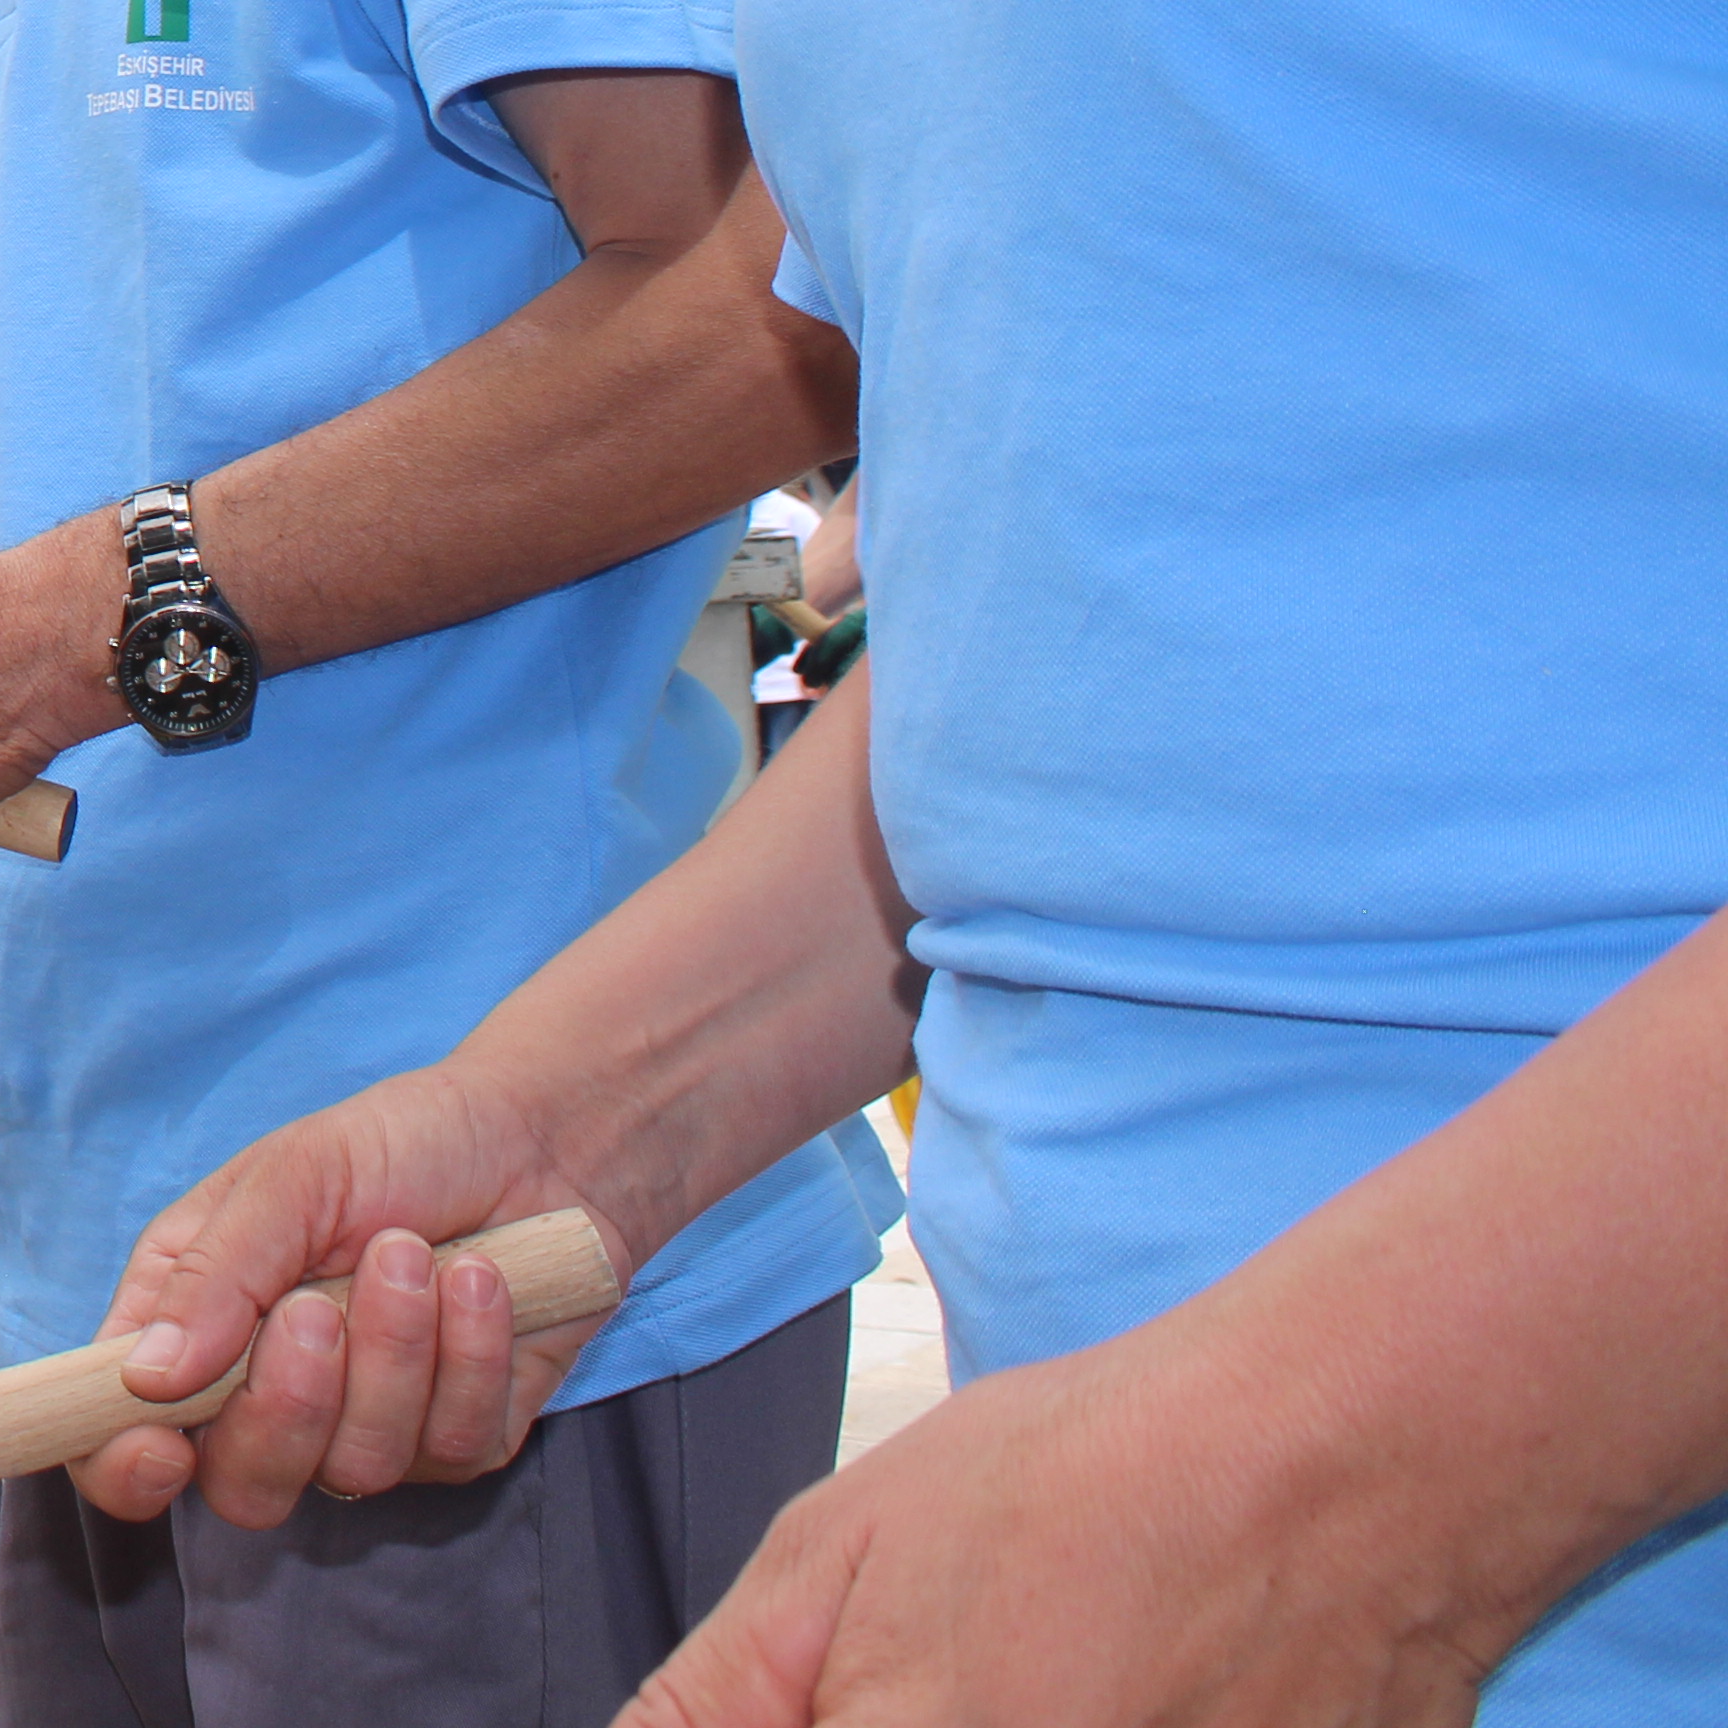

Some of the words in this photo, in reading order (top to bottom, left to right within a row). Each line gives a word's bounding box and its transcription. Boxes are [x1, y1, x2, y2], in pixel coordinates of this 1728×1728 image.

[117, 49, 206, 79] ESKİŞEHİR
[85, 88, 140, 117] TEPEBAŞI
[144, 83, 256, 112] BELEDİYESİ
